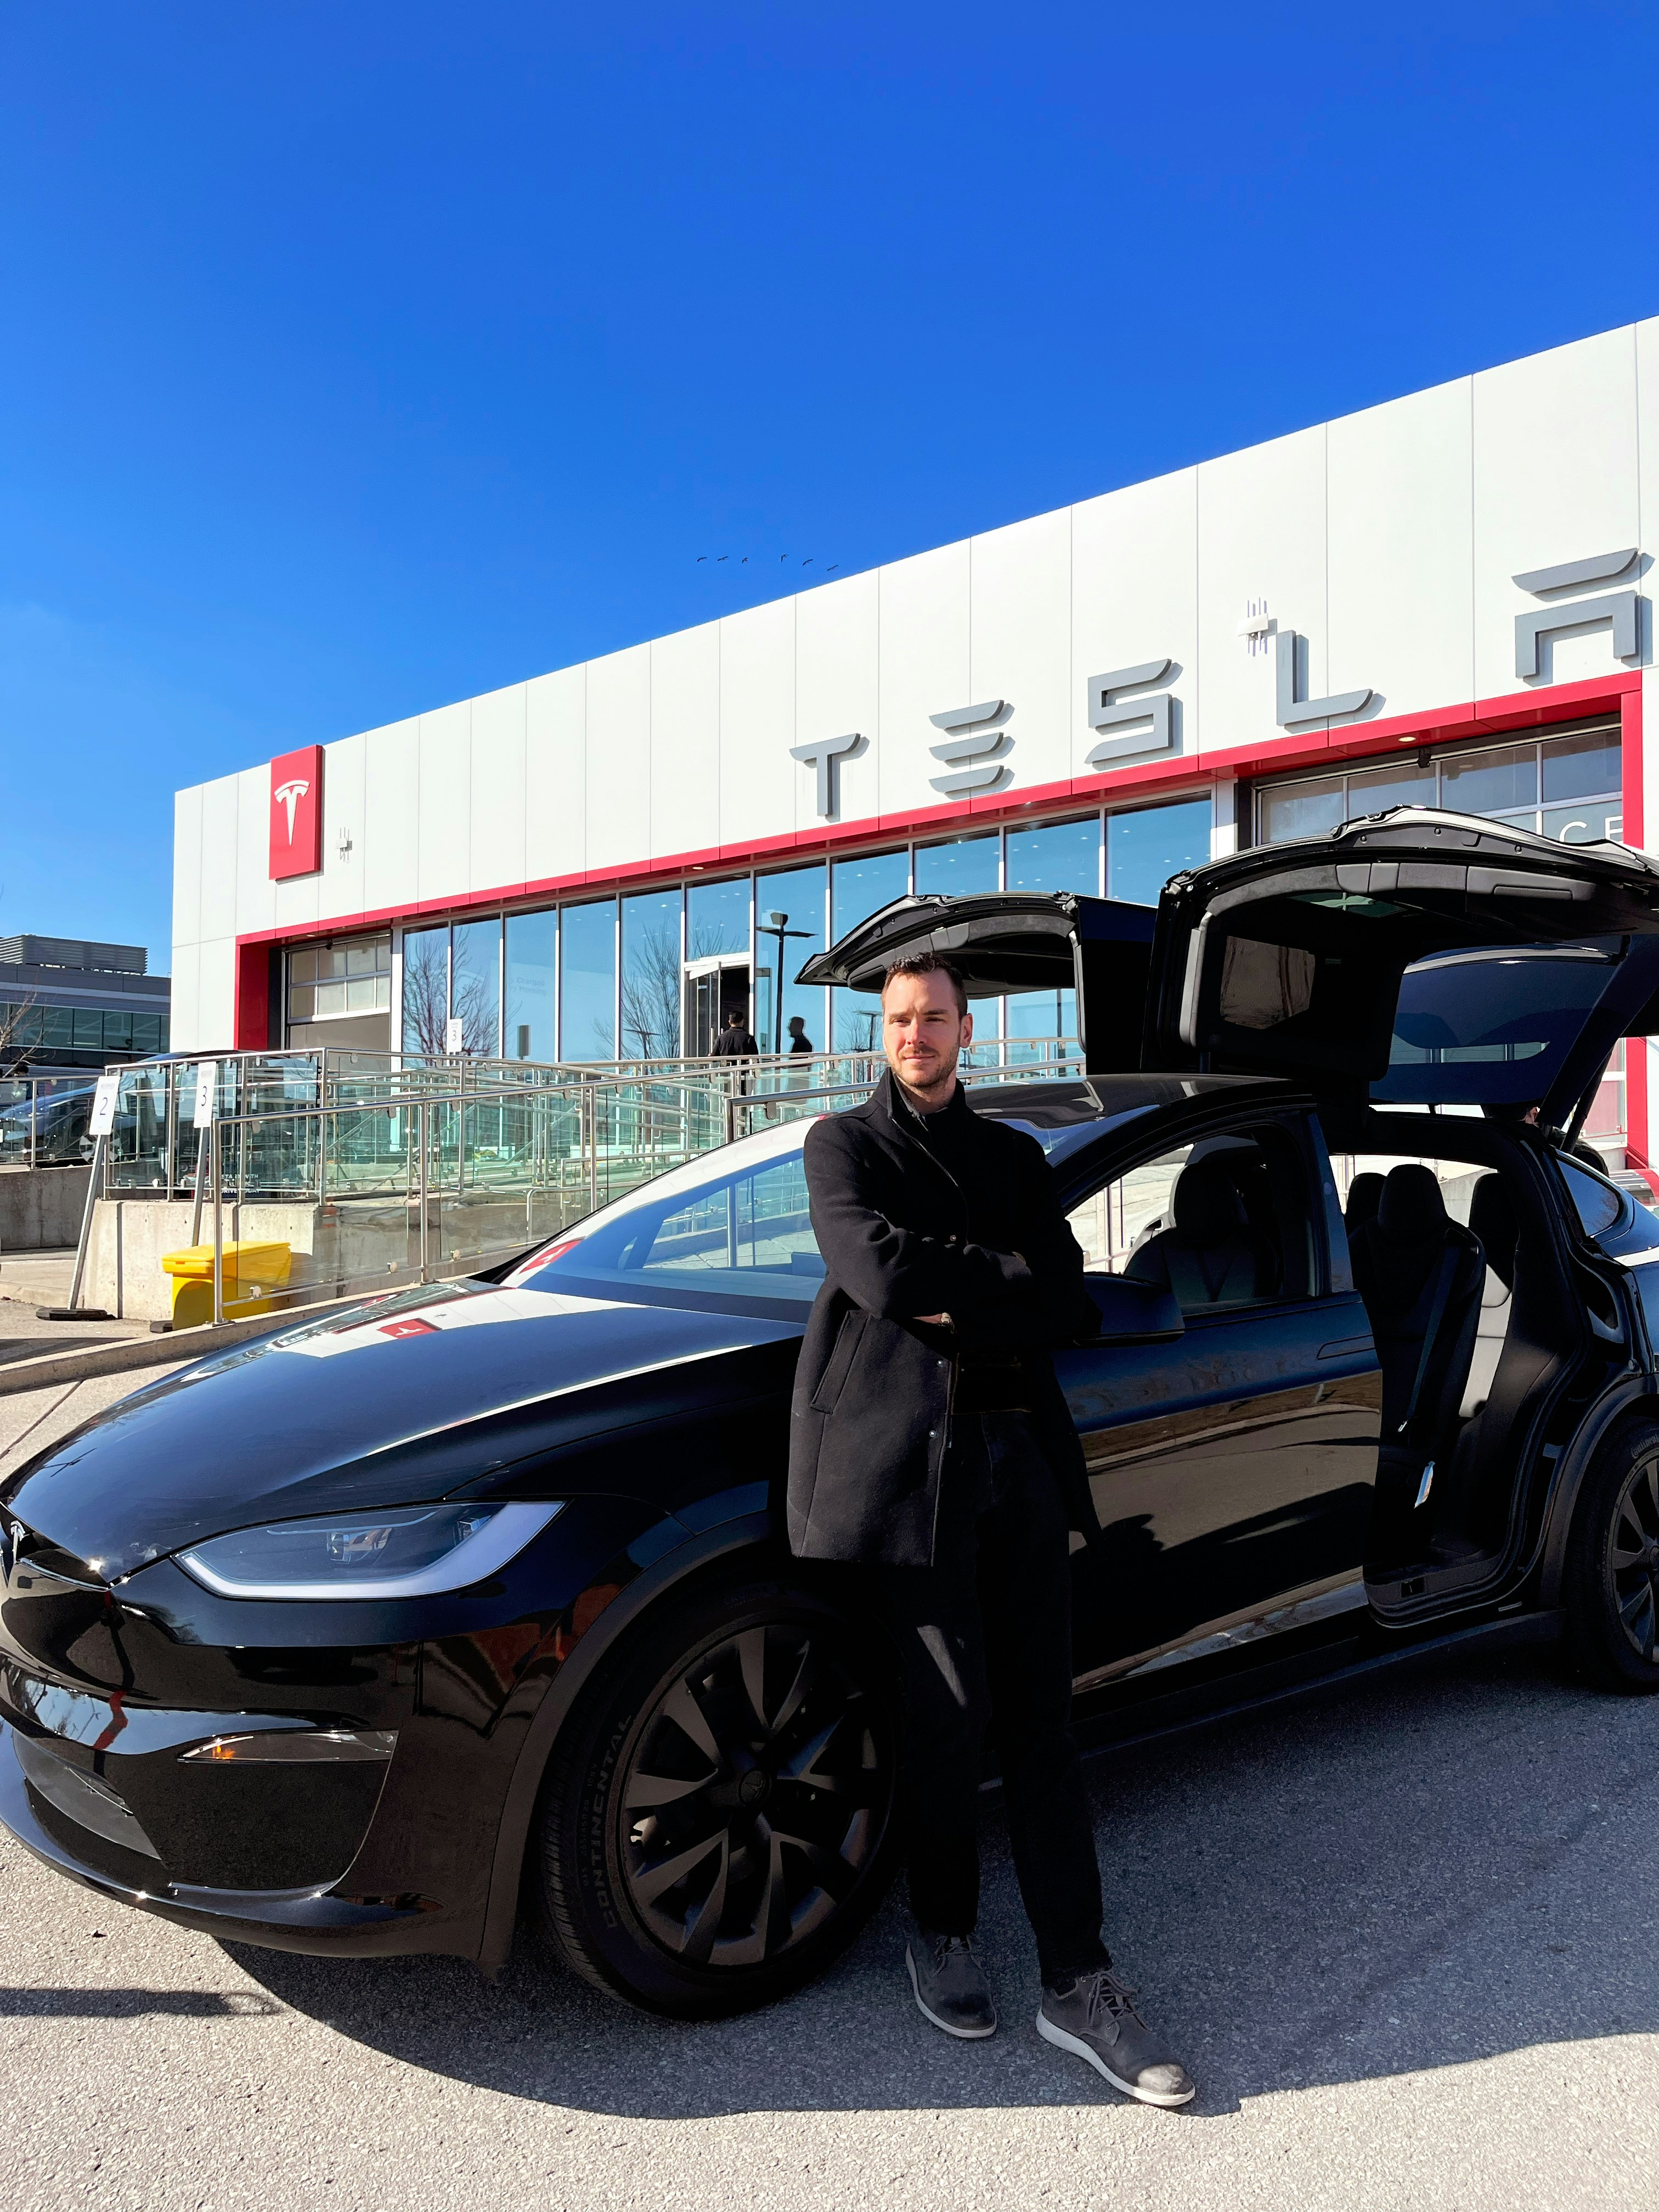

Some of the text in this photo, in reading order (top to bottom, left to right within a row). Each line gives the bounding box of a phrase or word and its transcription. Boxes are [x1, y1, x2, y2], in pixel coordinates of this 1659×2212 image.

[789, 548, 1639, 816] TESLA
[452, 1030, 457, 1041] 3
[99, 1097, 108, 1115] 2
[201, 1086, 207, 1107] 3
[591, 1714, 633, 1929] CONTINENTAL
